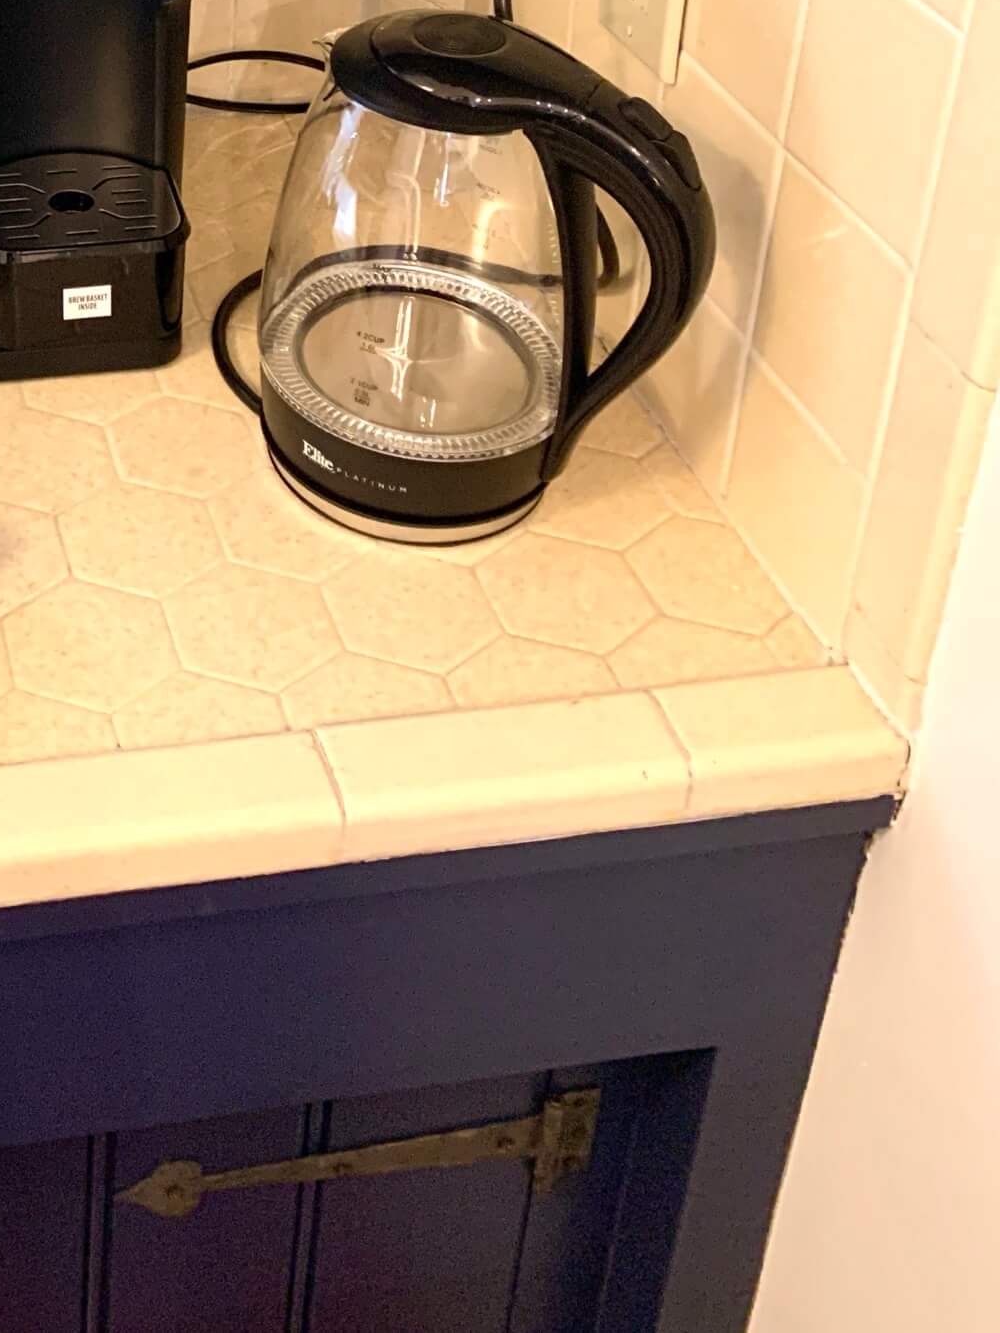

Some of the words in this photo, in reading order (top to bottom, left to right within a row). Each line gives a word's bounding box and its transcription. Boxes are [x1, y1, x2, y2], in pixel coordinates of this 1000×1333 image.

[68, 296, 85, 304] BREW
[86, 293, 107, 302] BASKET
[78, 302, 96, 310] INSIDE
[302, 440, 334, 471] Elite
[336, 467, 407, 493] PLATINUM
